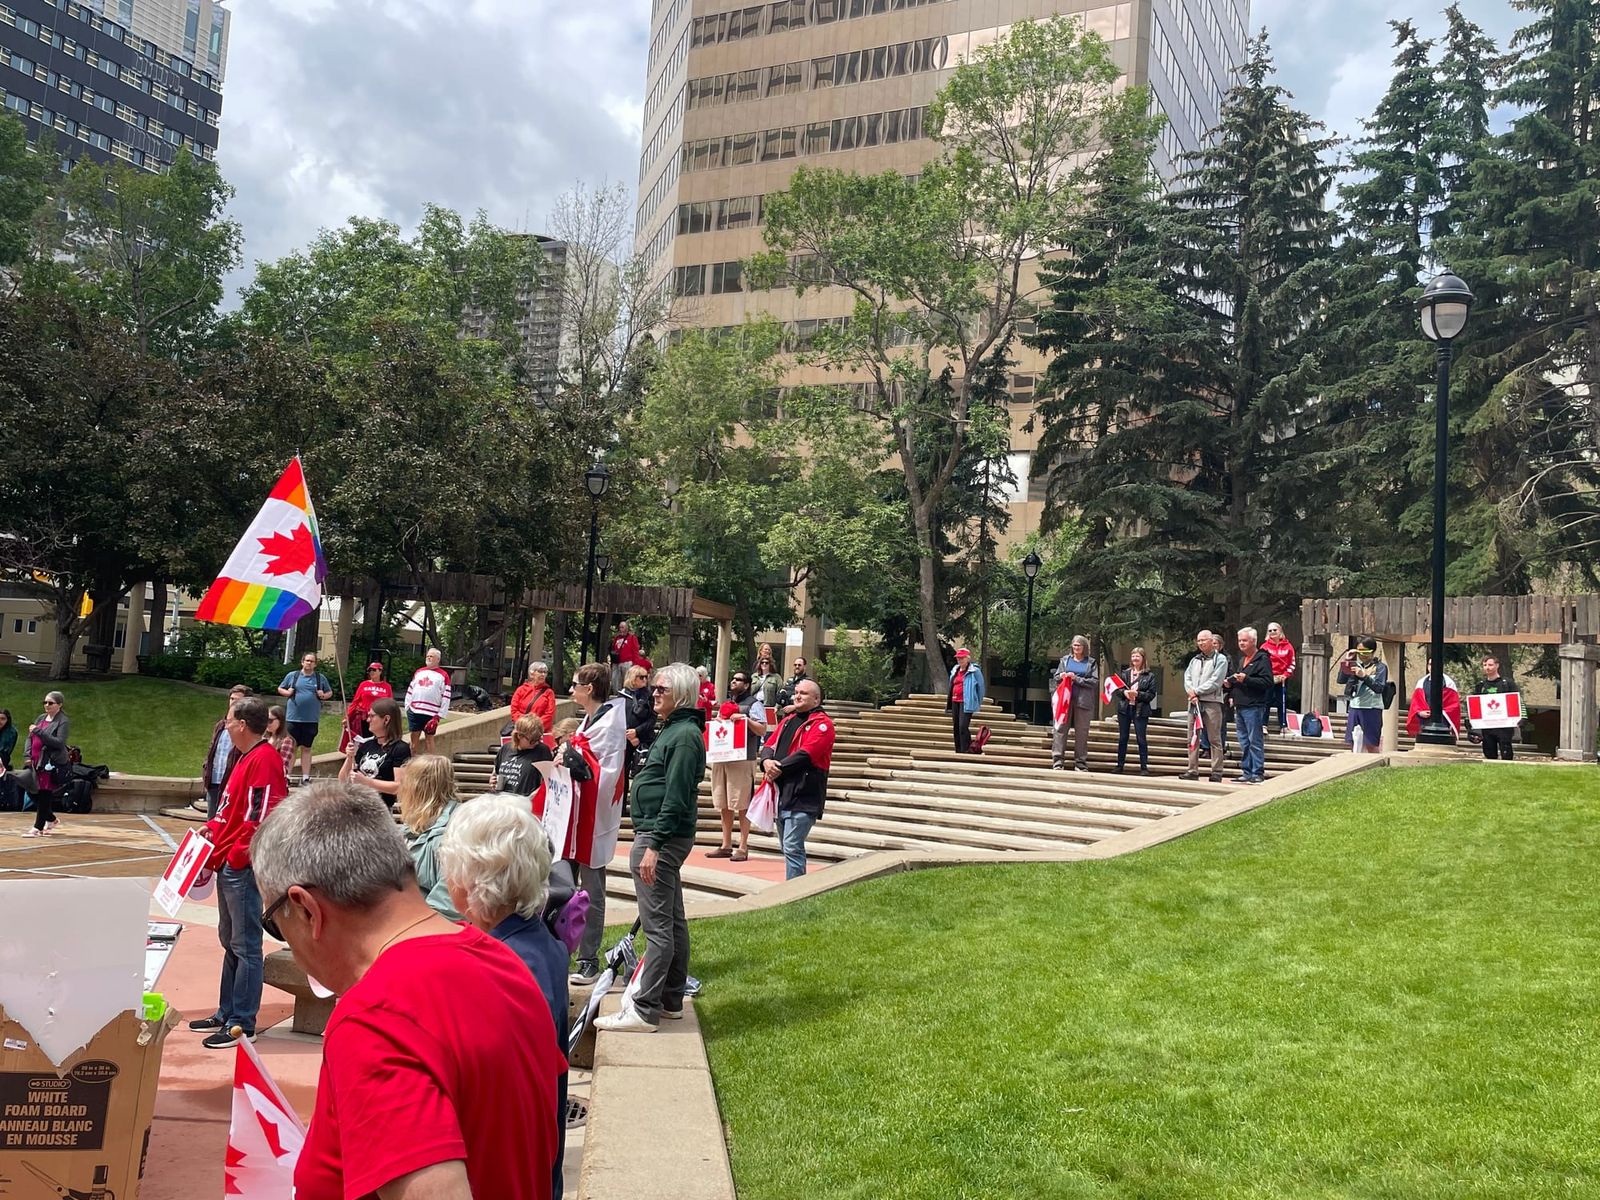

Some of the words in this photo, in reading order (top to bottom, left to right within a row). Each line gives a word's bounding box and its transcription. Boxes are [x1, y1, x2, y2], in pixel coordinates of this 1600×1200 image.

[1001, 669, 1017, 678] 800
[41, 1080, 67, 1088] STUDIO
[27, 1091, 69, 1103] WHITE
[4, 1104, 41, 1116] FOAM
[43, 1105, 88, 1117] BOARD
[51, 1120, 94, 1132] BLANC
[6, 1133, 23, 1145] EN
[25, 1133, 79, 1145] MOUSSE
